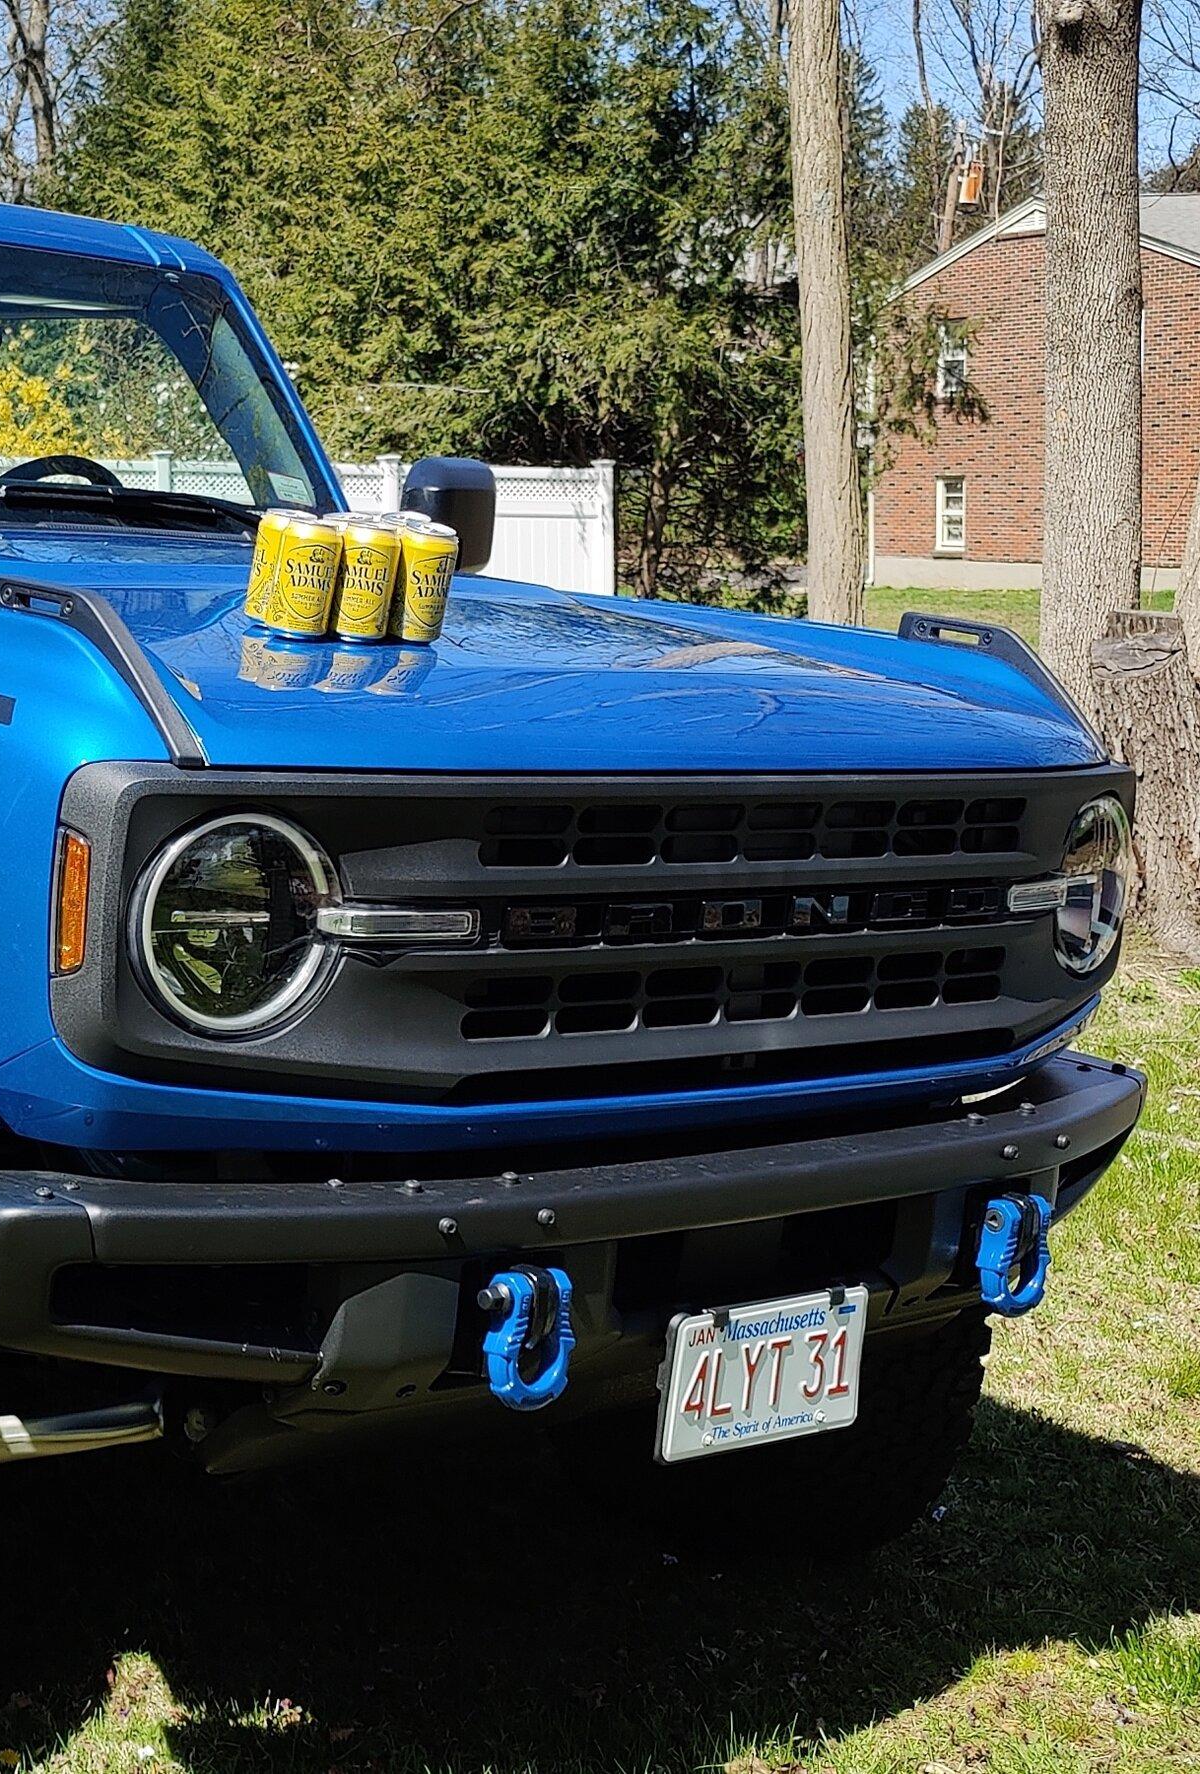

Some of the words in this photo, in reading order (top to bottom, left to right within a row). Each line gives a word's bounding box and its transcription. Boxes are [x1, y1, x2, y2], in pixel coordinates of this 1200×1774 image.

[345, 565, 389, 583] AMUEL
[410, 570, 452, 586] SAMU
[346, 577, 383, 596] DAMS
[412, 586, 449, 598] ADAM
[504, 887, 1000, 937] BRONCO
[688, 1328, 716, 1347] JAN
[723, 1309, 826, 1343] Massachusetts
[680, 1335, 793, 1421] 4LYT
[800, 1327, 850, 1398] 31
[712, 1426, 730, 1440] The
[733, 1420, 760, 1438] Spirit
[762, 1416, 772, 1433] of
[773, 1411, 814, 1429] America
